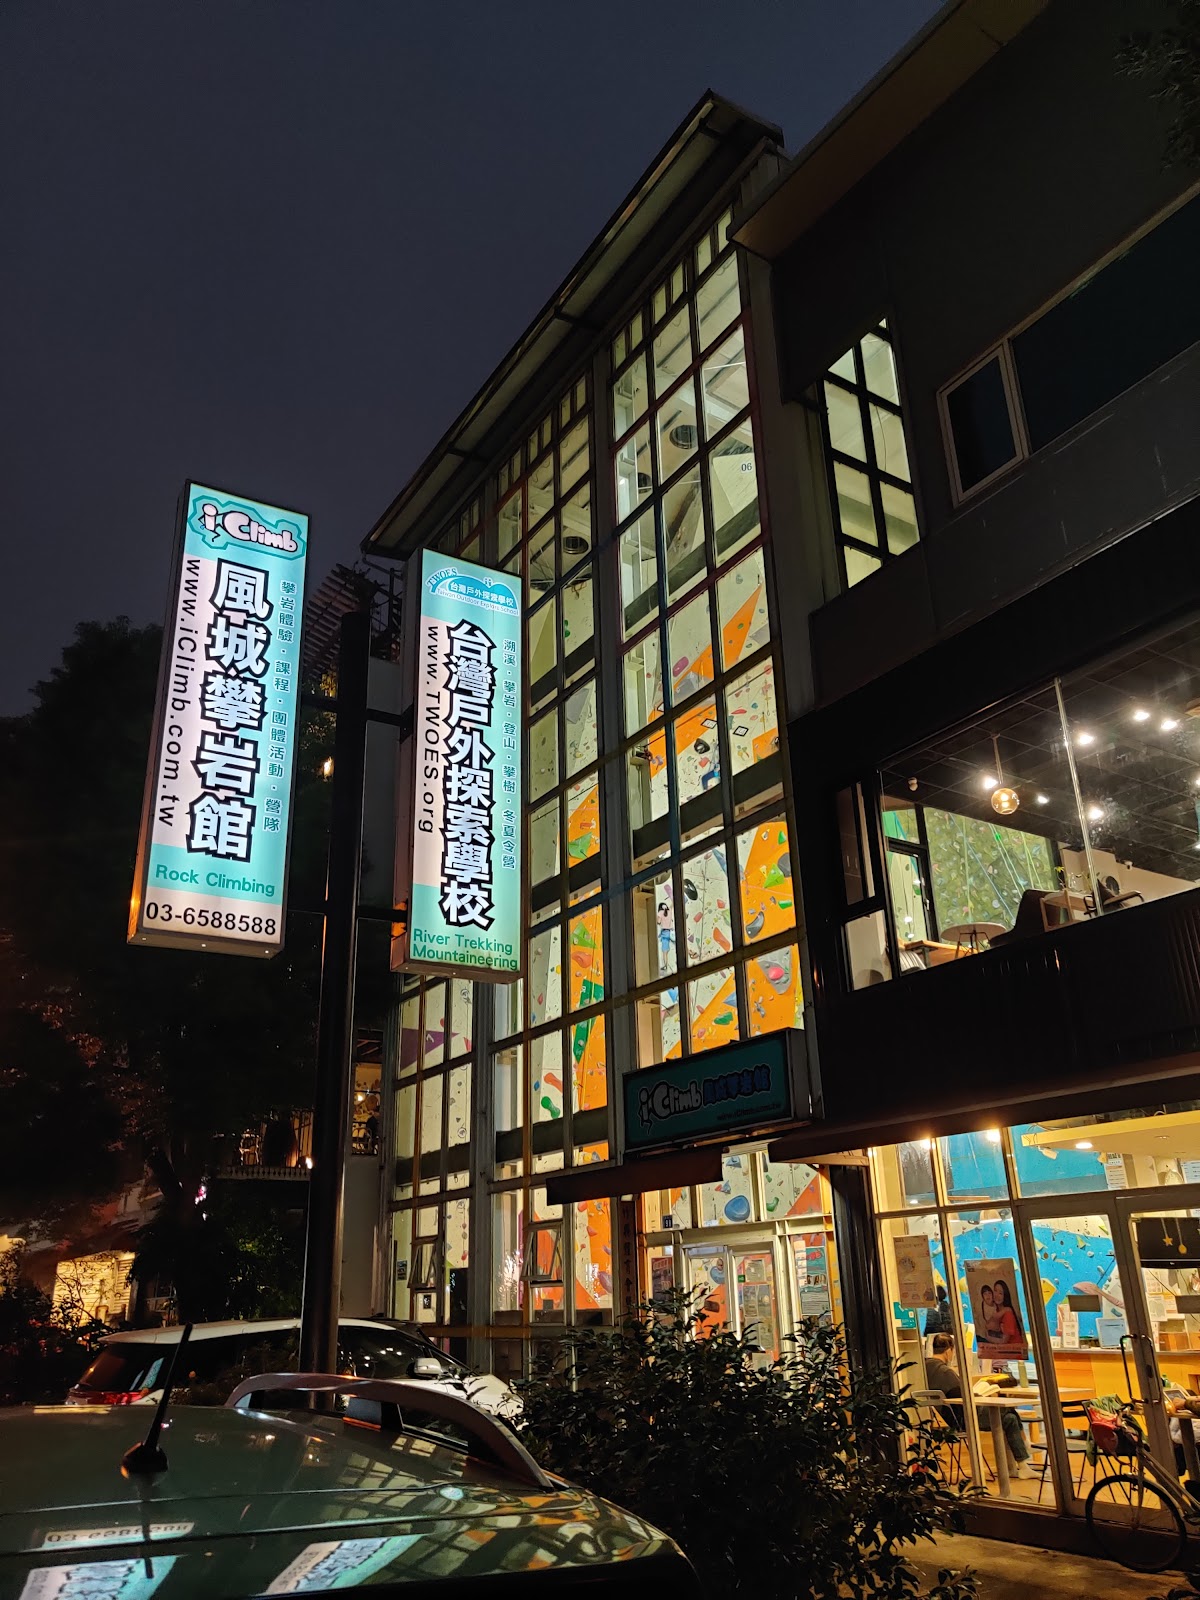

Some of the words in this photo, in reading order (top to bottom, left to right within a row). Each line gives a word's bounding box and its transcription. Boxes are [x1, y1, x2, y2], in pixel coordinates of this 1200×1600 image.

[741, 463, 753, 471] 06
[201, 503, 298, 552] iClimb
[437, 588, 456, 598] Taiwan
[456, 594, 479, 605] Outdoor
[158, 559, 201, 827] www.iClimb.com.tw
[185, 557, 274, 863] 風城攀岩館
[418, 625, 441, 834] www.TWOES.org
[438, 618, 498, 932] 台灣戶外探索學校
[155, 863, 200, 885] Rock
[205, 872, 275, 897] Climbing
[145, 901, 277, 936] 03-6588588
[412, 943, 518, 970] Mountaineering
[413, 928, 450, 946] River
[454, 933, 513, 955] Trekking
[639, 1081, 703, 1122] iClimb
